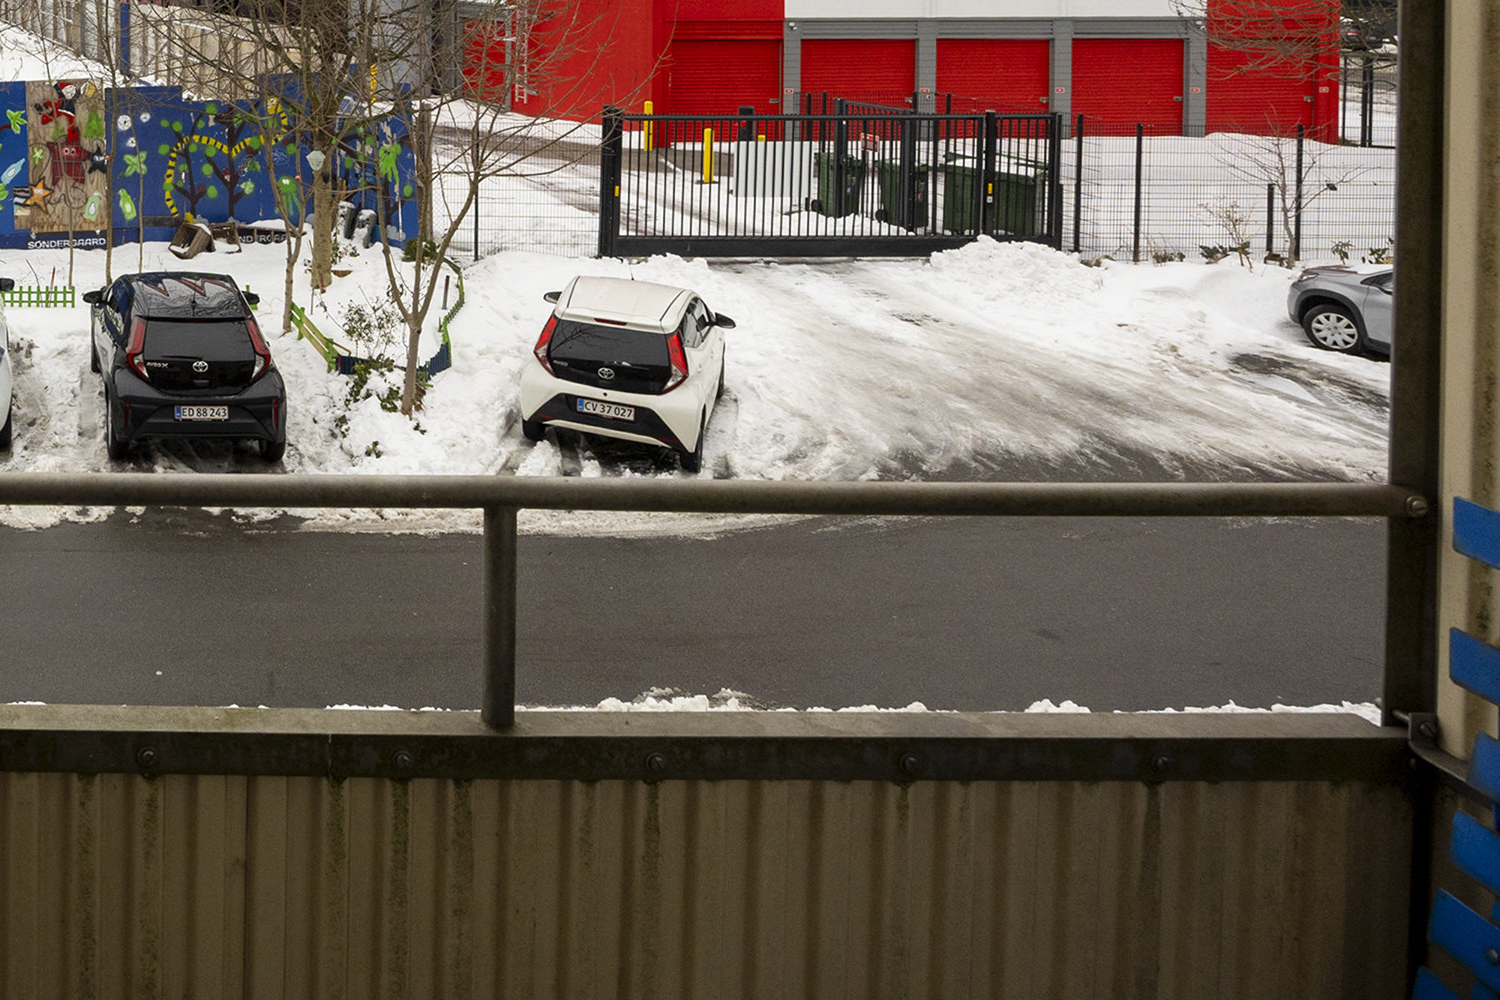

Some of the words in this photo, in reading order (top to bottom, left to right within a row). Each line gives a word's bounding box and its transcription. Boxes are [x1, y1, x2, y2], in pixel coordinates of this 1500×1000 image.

[182, 407, 195, 417] ED
[196, 407, 208, 417] 88
[209, 407, 227, 417] 243
[584, 401, 598, 411] CV
[600, 403, 612, 414] 37
[614, 406, 633, 418] 027
